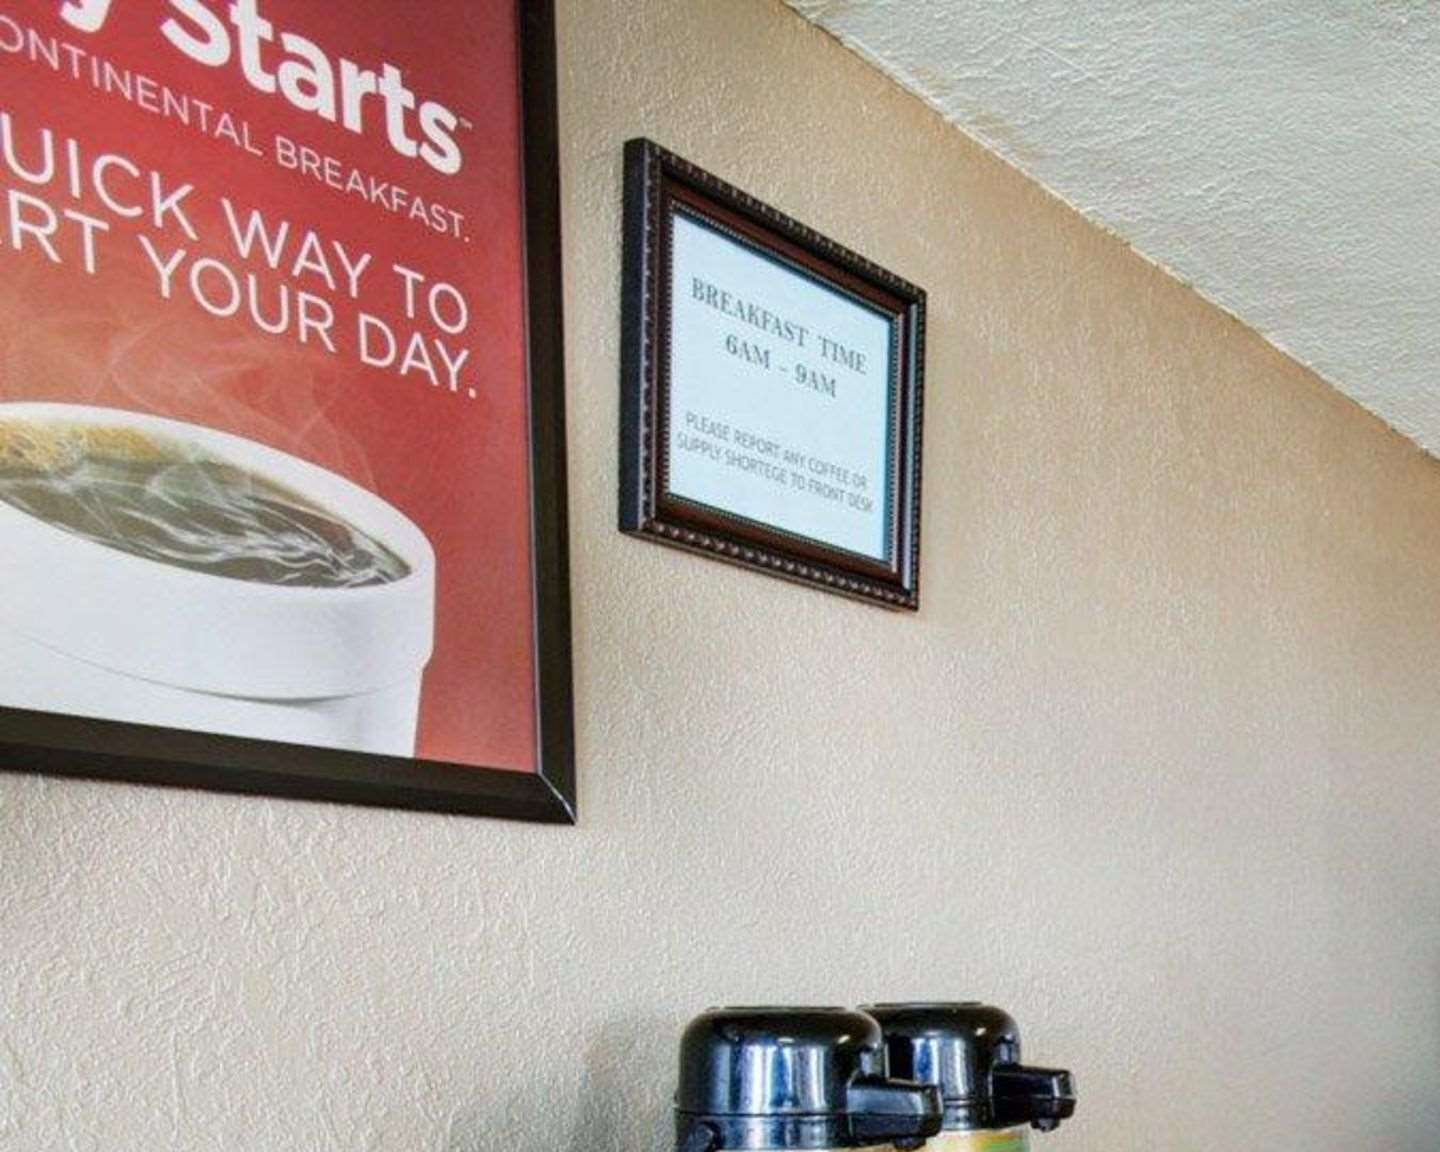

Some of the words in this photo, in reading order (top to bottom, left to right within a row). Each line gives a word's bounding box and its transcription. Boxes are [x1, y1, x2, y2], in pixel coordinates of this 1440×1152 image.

[0, 112, 199, 241] UICK
[221, 197, 372, 299] WAY
[393, 264, 469, 335] TO
[276, 135, 470, 243] BREAKFAST.
[8, 188, 109, 275] RT
[138, 233, 337, 353] YOUR
[358, 312, 477, 400] DAY.
[691, 277, 809, 348] BREAKFAST
[818, 335, 867, 375] TIME
[725, 334, 771, 369] 6AM
[795, 363, 837, 398] 9AM
[677, 431, 725, 462] SUPPLY
[791, 471, 806, 491] TO
[807, 479, 846, 503] FRONT
[847, 491, 873, 513] DESK
[685, 411, 730, 442] PLEASE
[734, 428, 781, 460] REPORT
[783, 449, 806, 468] ANY
[808, 457, 851, 487] COFFEE
